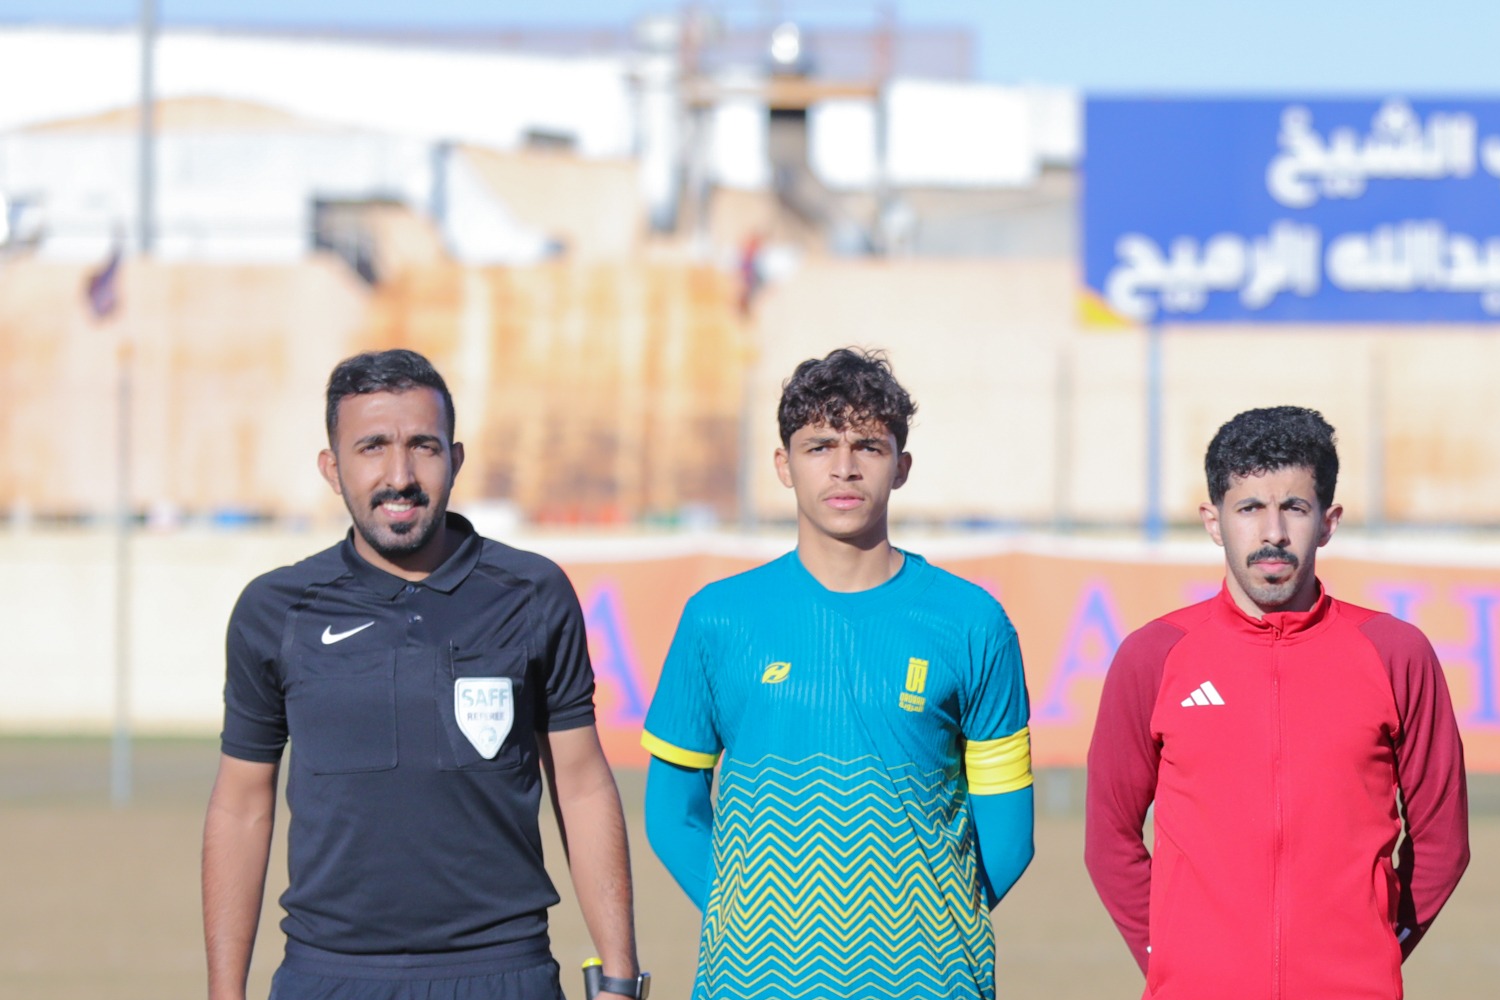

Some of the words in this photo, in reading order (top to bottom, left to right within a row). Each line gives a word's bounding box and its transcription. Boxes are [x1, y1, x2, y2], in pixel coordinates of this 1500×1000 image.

[1266, 98, 1476, 209] الشيخ
[1104, 218, 1322, 324] الرميح
[461, 688, 509, 706] SAFF
